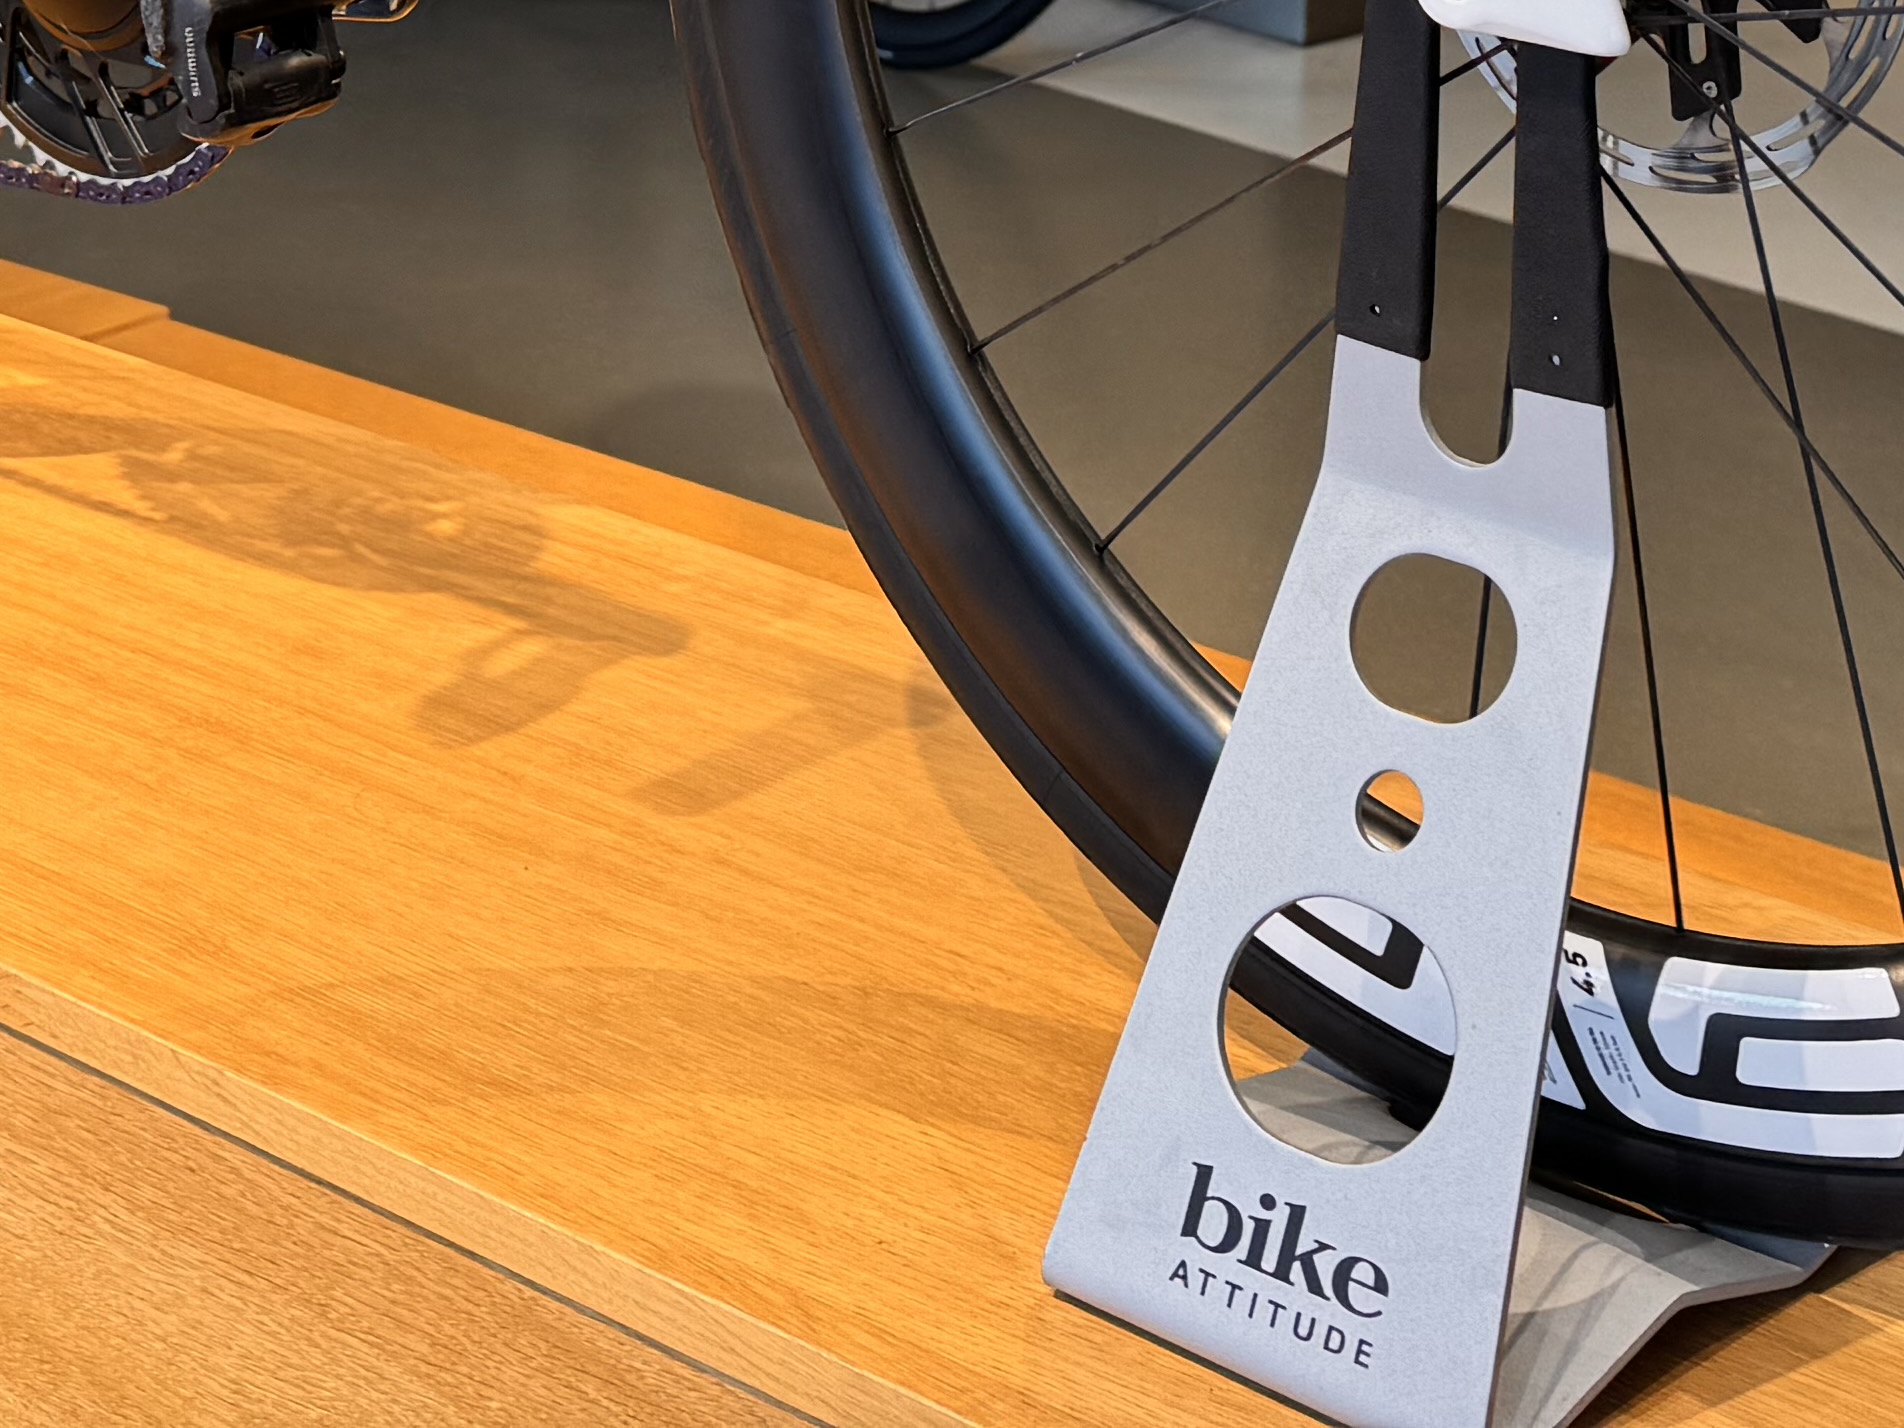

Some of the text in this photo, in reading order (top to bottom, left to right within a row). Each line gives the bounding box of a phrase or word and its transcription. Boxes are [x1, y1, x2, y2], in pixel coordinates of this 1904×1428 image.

[1563, 948, 1594, 997] 4.5
[1179, 1162, 1391, 1319] bike
[1169, 1259, 1375, 1370] ATTITUDE
